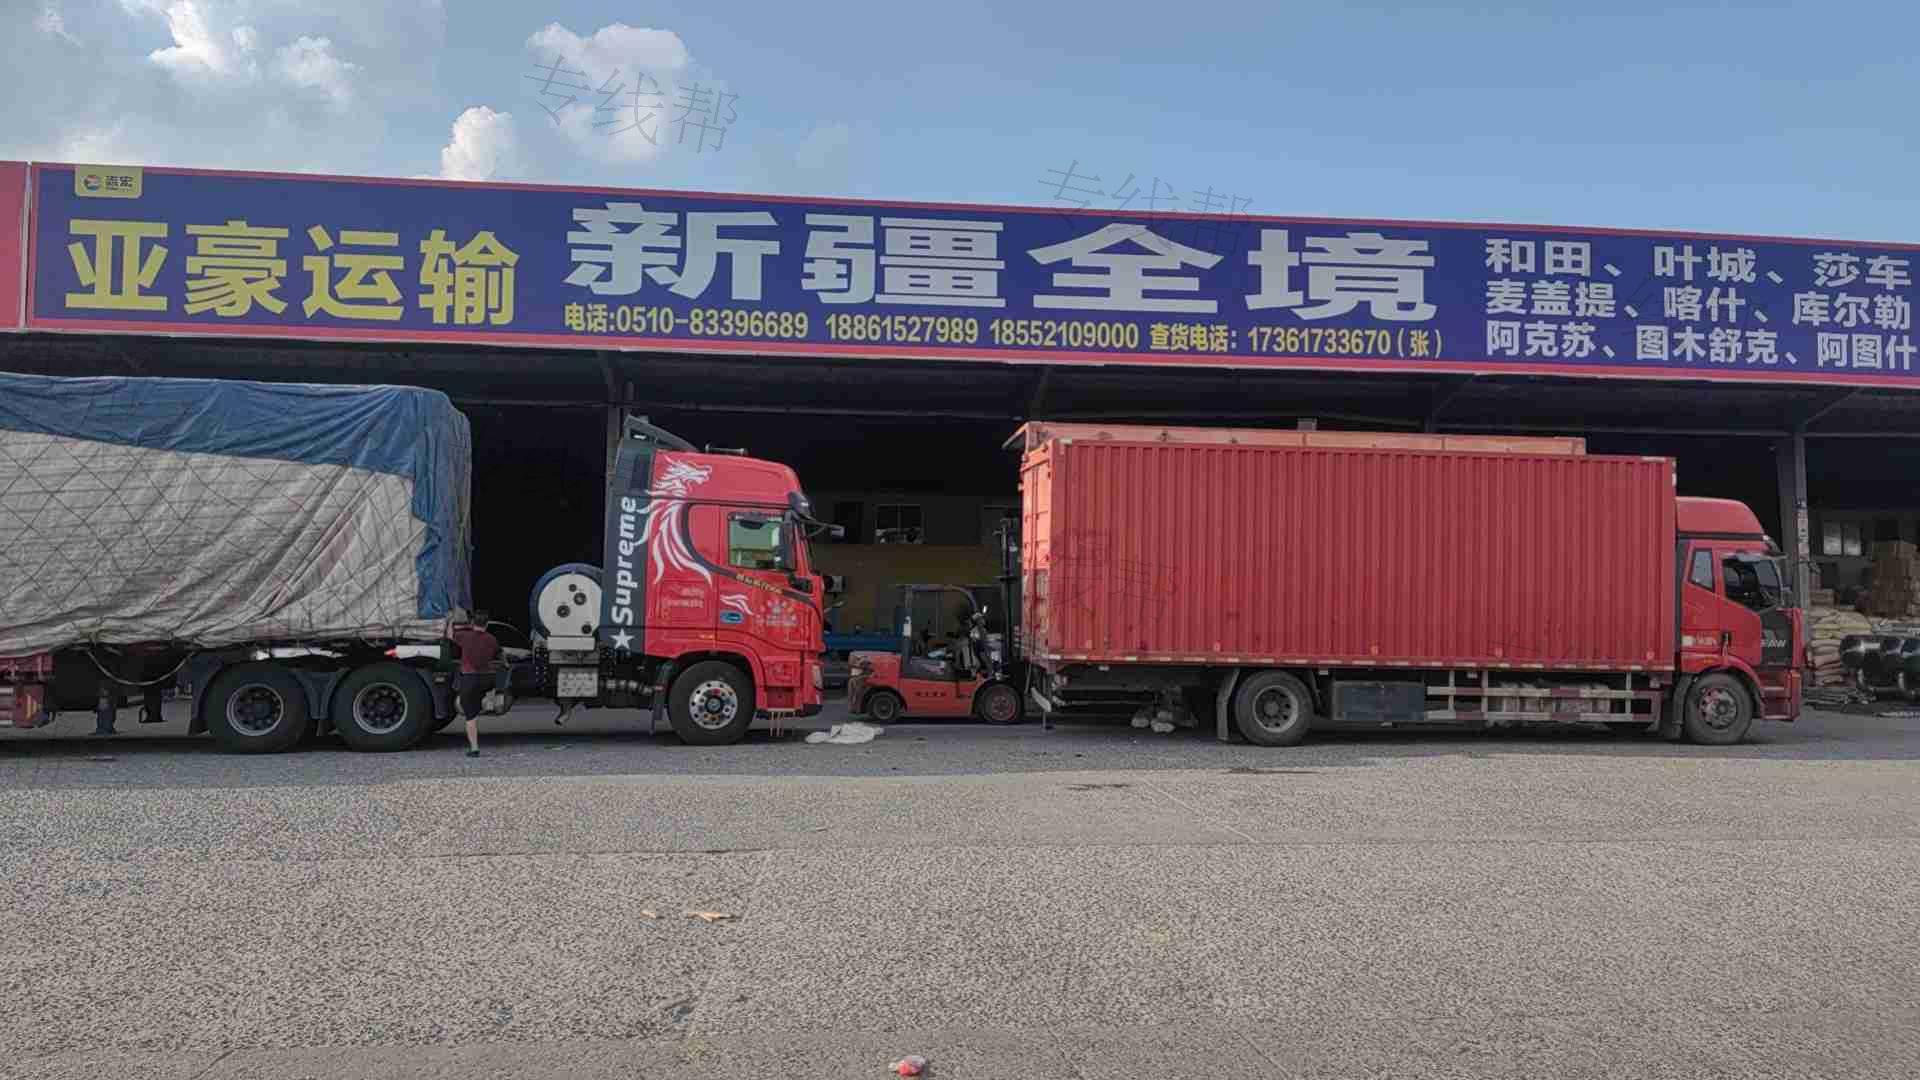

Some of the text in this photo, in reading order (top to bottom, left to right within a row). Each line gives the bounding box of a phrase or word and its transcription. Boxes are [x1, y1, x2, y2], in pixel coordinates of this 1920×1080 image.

[65, 219, 520, 326] 亚豪运输
[562, 202, 1437, 321] 新疆全境
[825, 313, 978, 344] 18861527989
[990, 319, 1139, 348] 18552109000
[612, 496, 638, 626] Supreme
